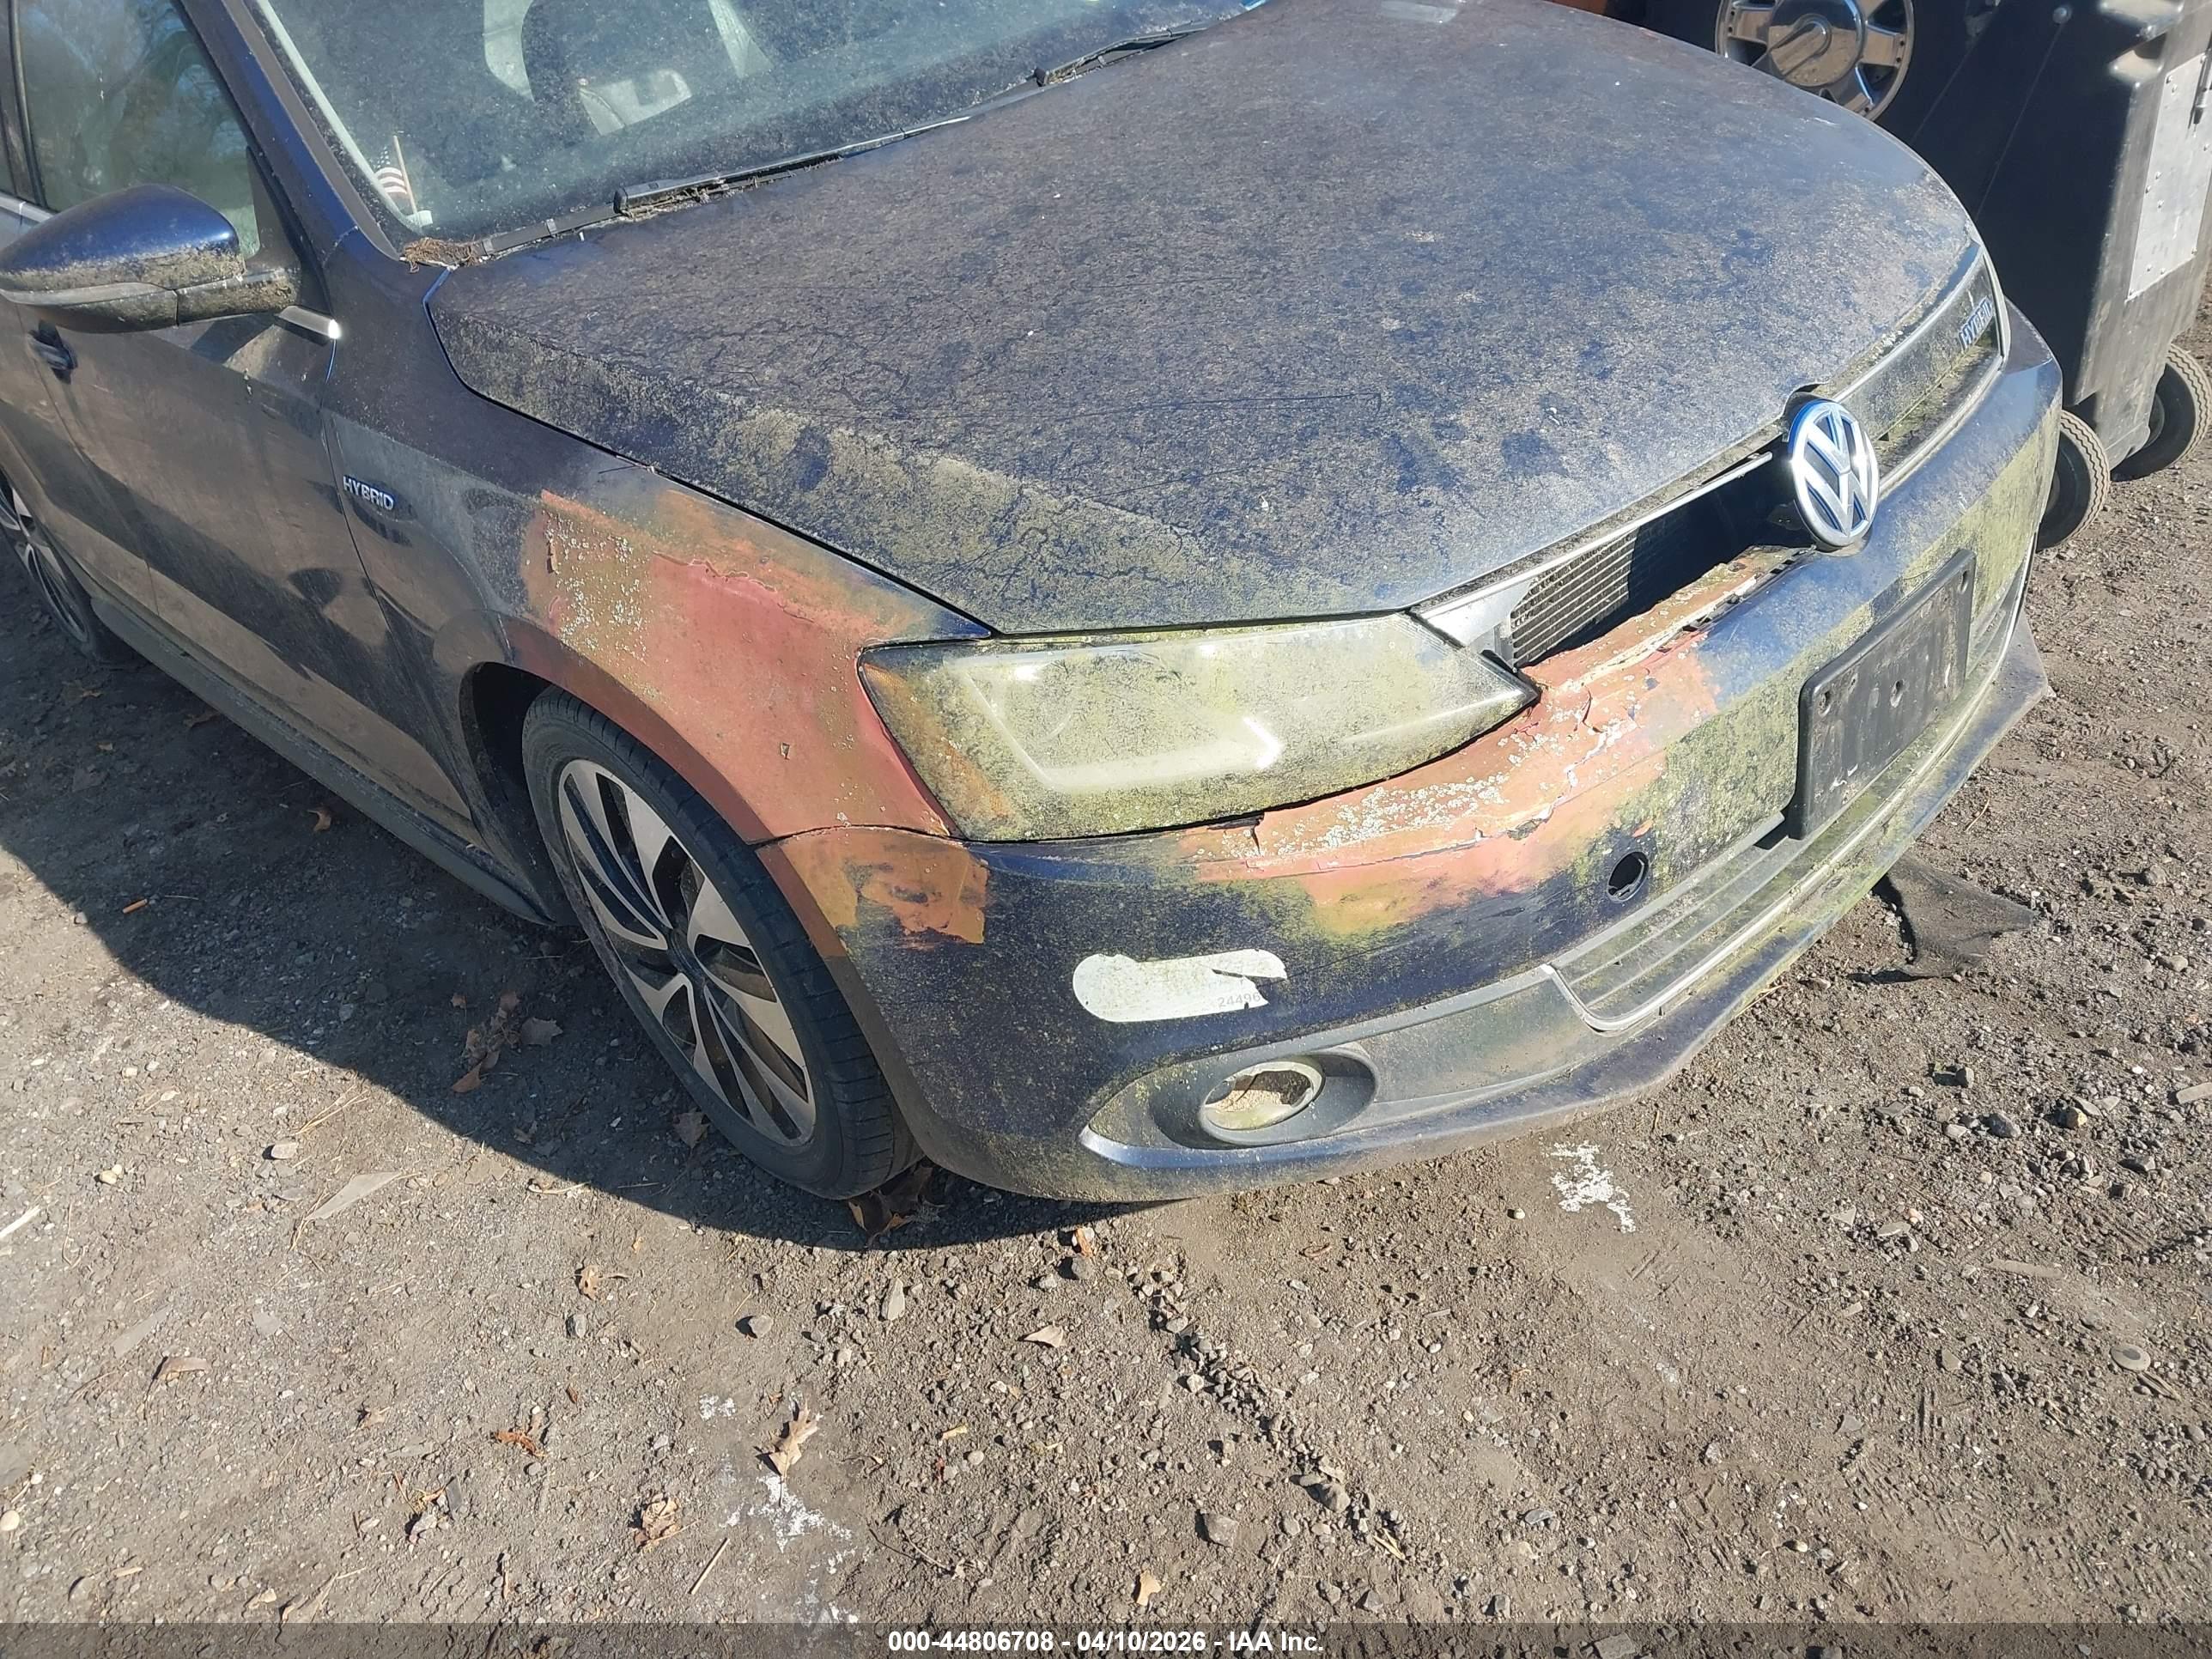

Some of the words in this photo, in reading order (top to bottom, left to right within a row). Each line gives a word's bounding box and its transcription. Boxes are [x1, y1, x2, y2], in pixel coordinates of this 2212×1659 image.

[1959, 297, 1993, 349] HYBRID
[343, 476, 394, 510] HYBRID
[1789, 400, 1879, 547] VW
